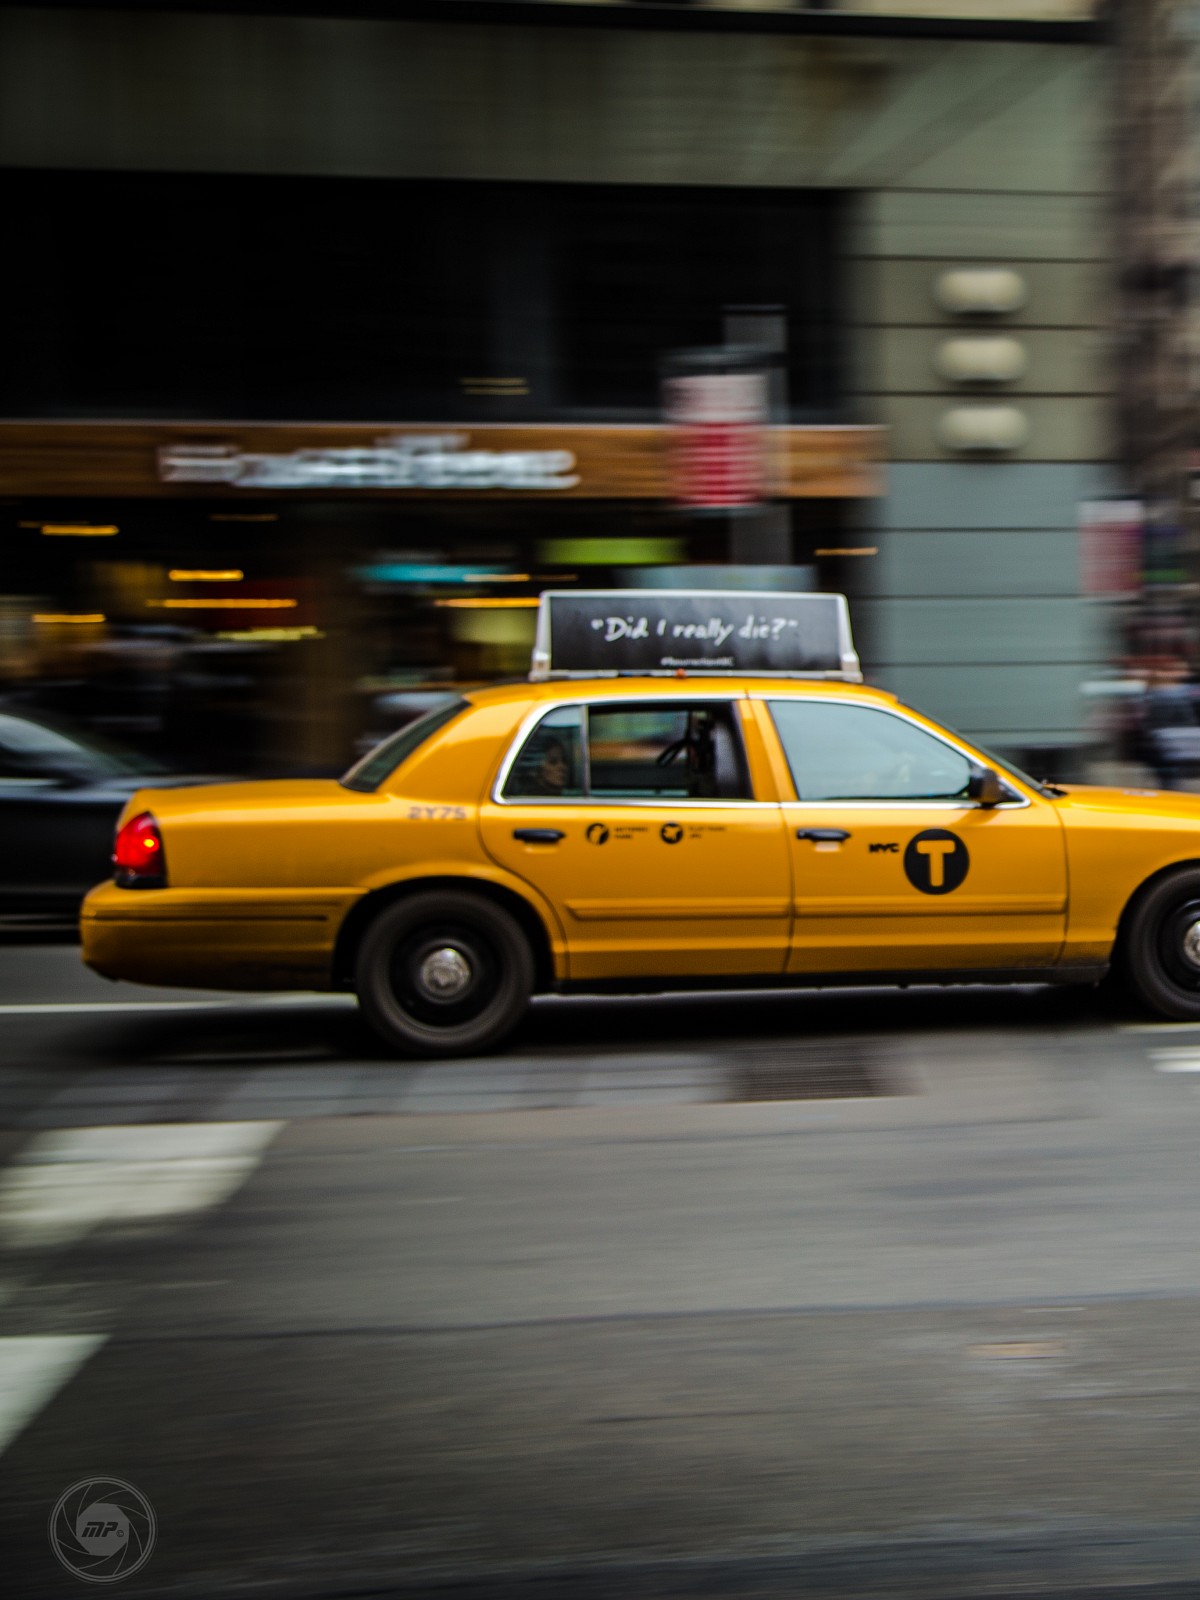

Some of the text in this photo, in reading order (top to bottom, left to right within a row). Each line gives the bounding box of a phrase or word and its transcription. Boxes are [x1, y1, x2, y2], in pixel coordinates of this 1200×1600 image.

[656, 618, 667, 636] I
[672, 617, 734, 647] really
[868, 840, 956, 887] NYC T
